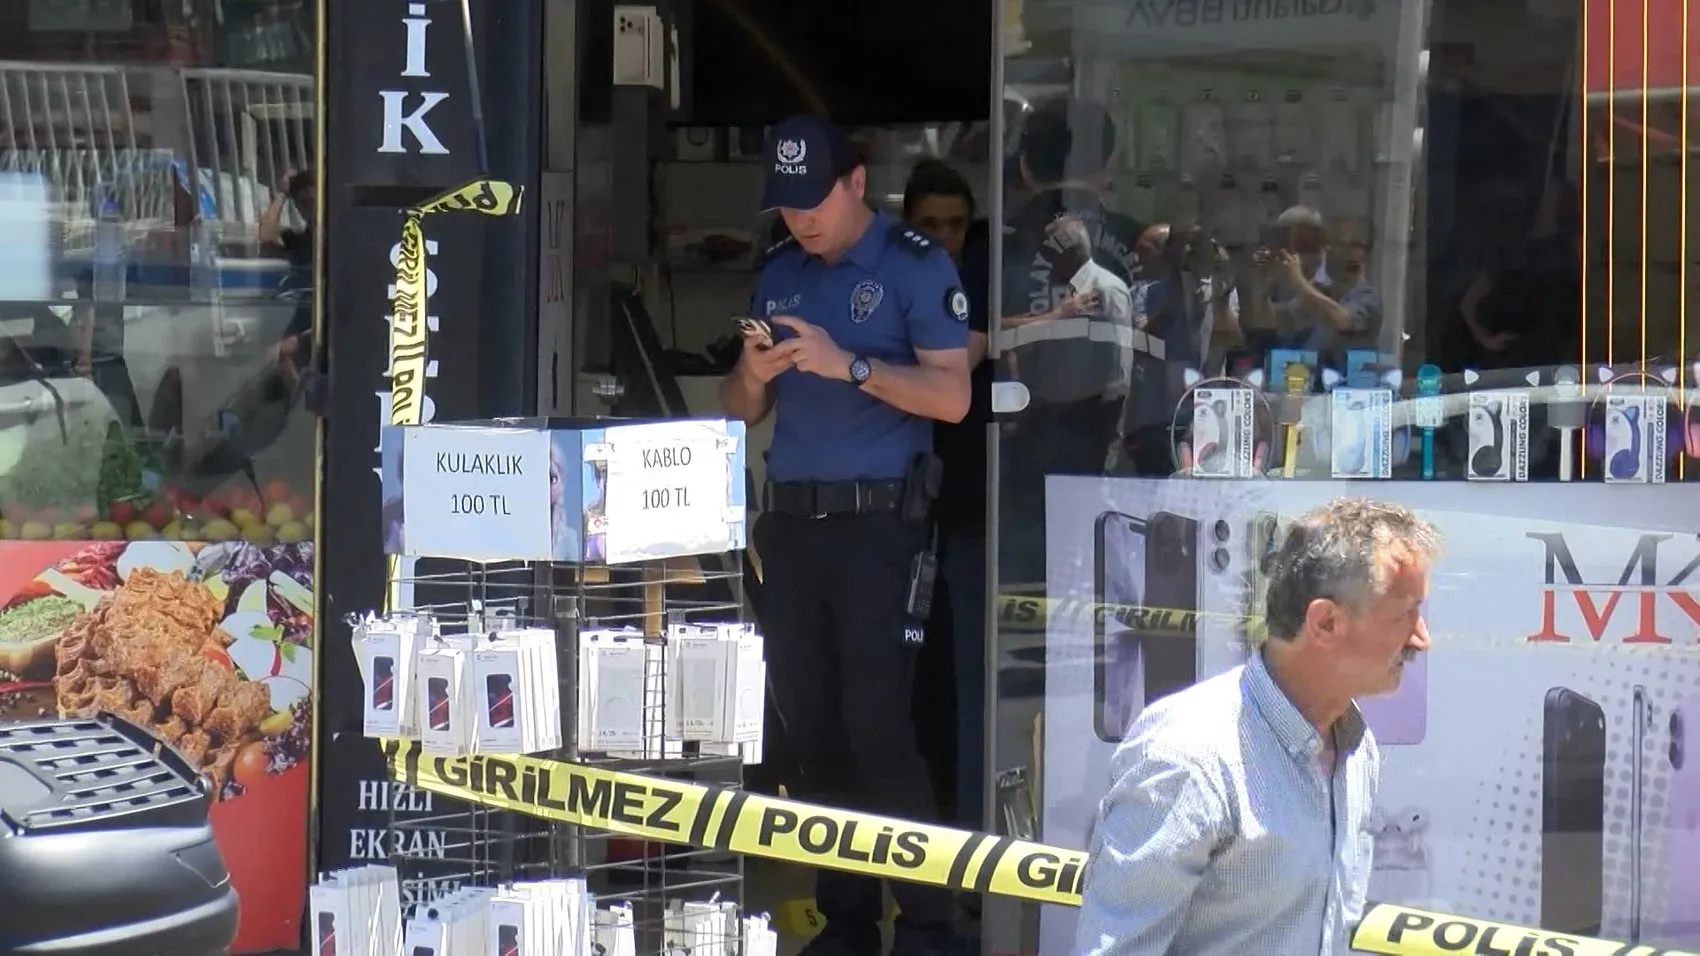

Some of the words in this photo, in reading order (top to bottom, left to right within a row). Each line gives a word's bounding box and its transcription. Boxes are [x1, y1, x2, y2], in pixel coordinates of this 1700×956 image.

[436, 452, 523, 475] KULAKLIK
[642, 446, 692, 469] KABLO
[451, 493, 485, 515] 100
[489, 494, 511, 515] TL
[642, 488, 670, 510] 100
[674, 486, 691, 507] TL
[358, 780, 433, 812] HIZLI
[350, 829, 447, 859] EKRAN
